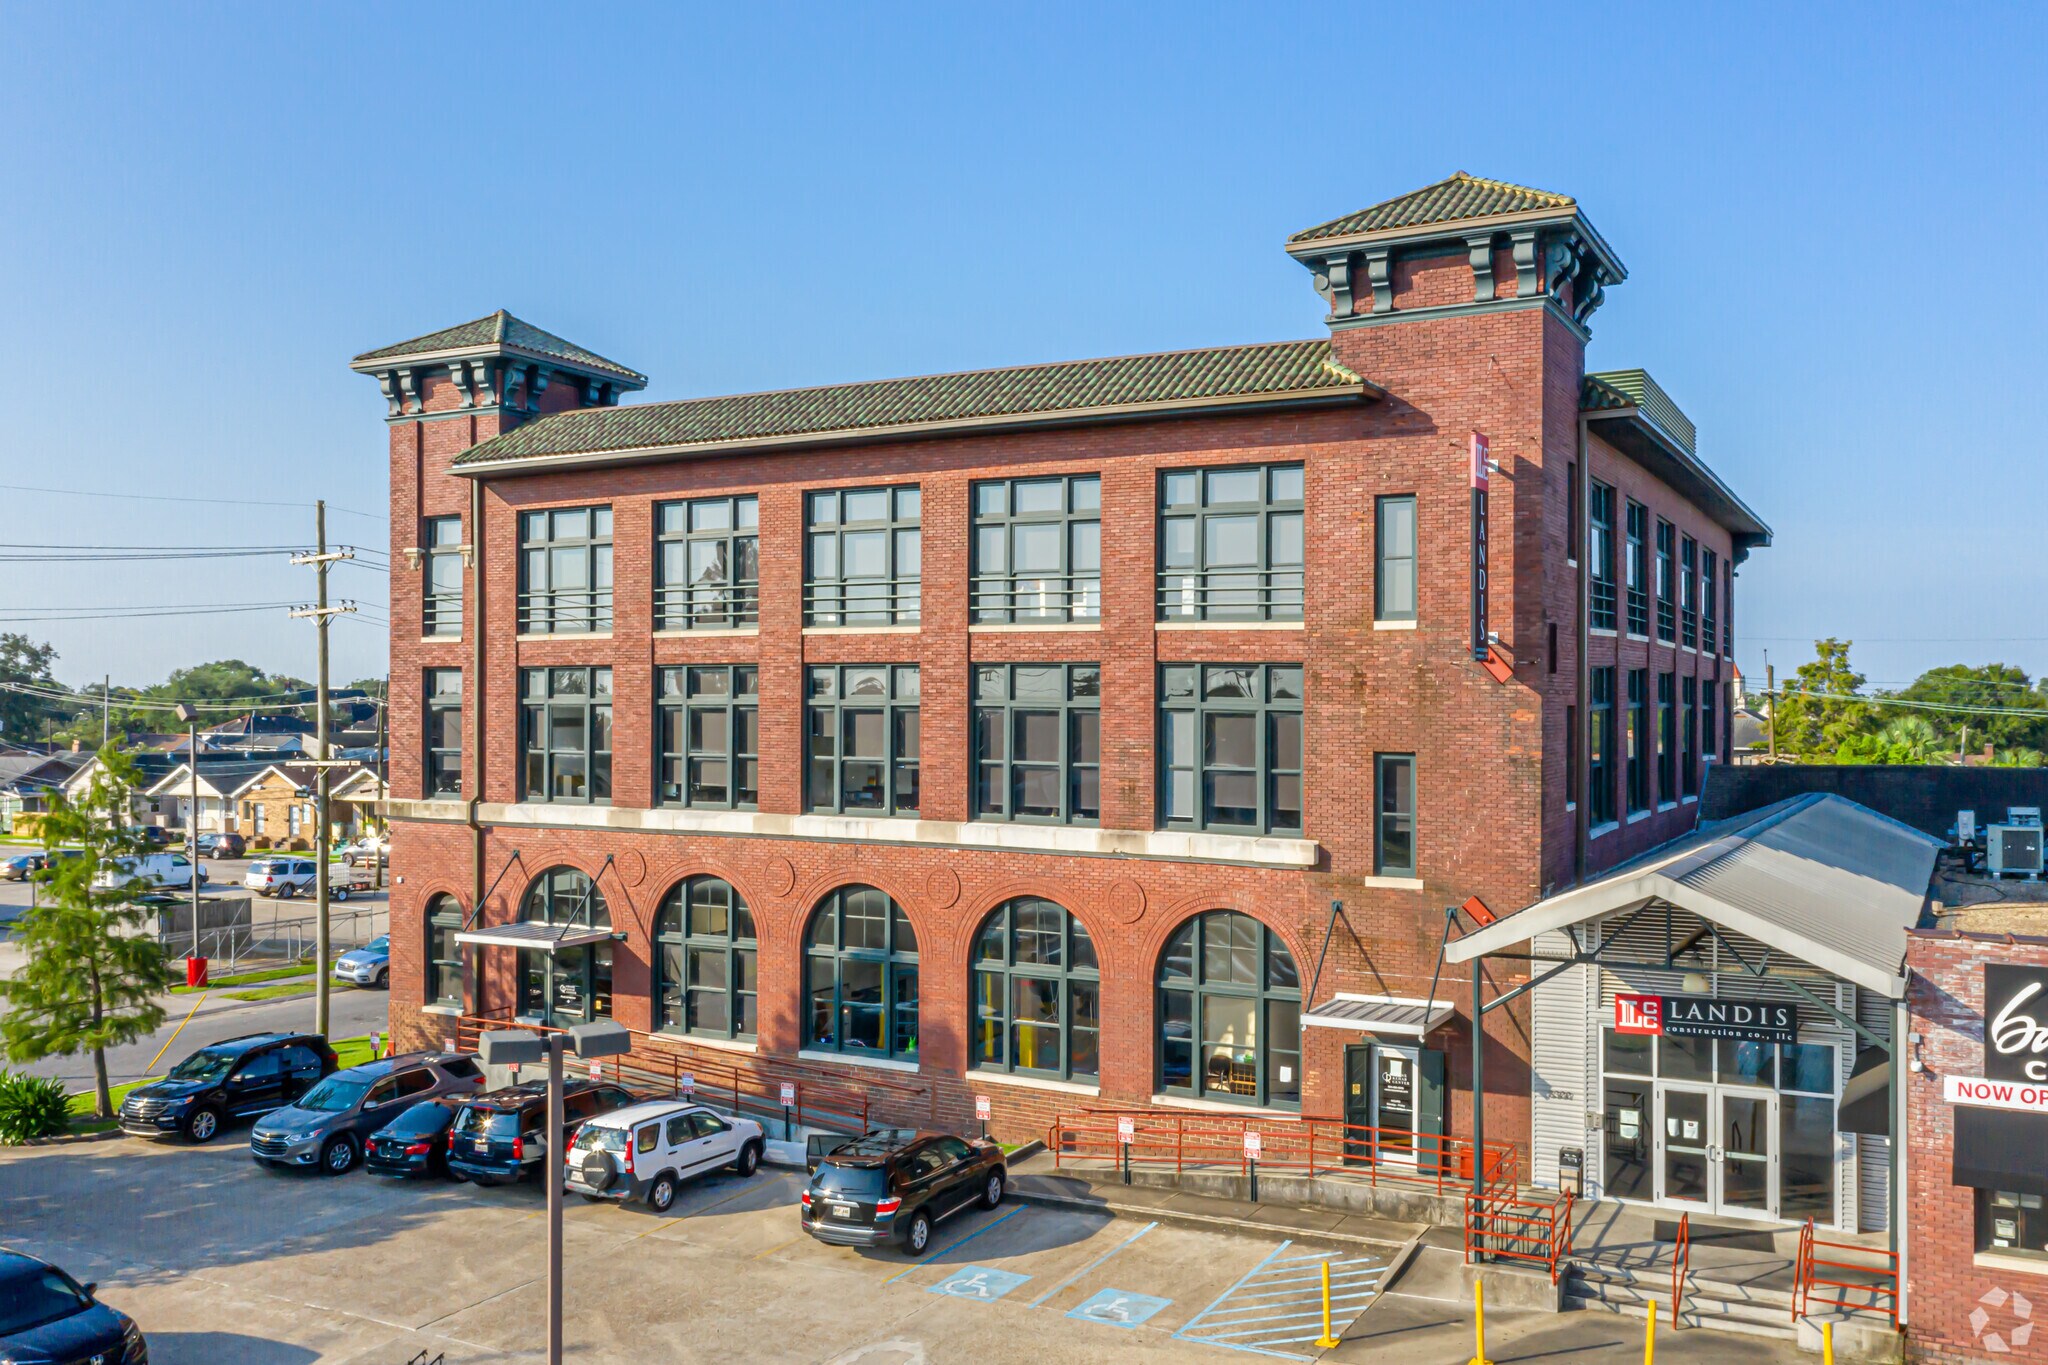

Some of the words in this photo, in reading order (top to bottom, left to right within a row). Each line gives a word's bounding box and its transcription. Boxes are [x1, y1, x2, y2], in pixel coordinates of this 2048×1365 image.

[1478, 493, 1486, 641] LANDIS
[1670, 1001, 1788, 1027] LANDIS
[1665, 1026, 1742, 1038] construction
[1776, 1033, 1793, 1041] llc
[1957, 1082, 2014, 1102] NOW
